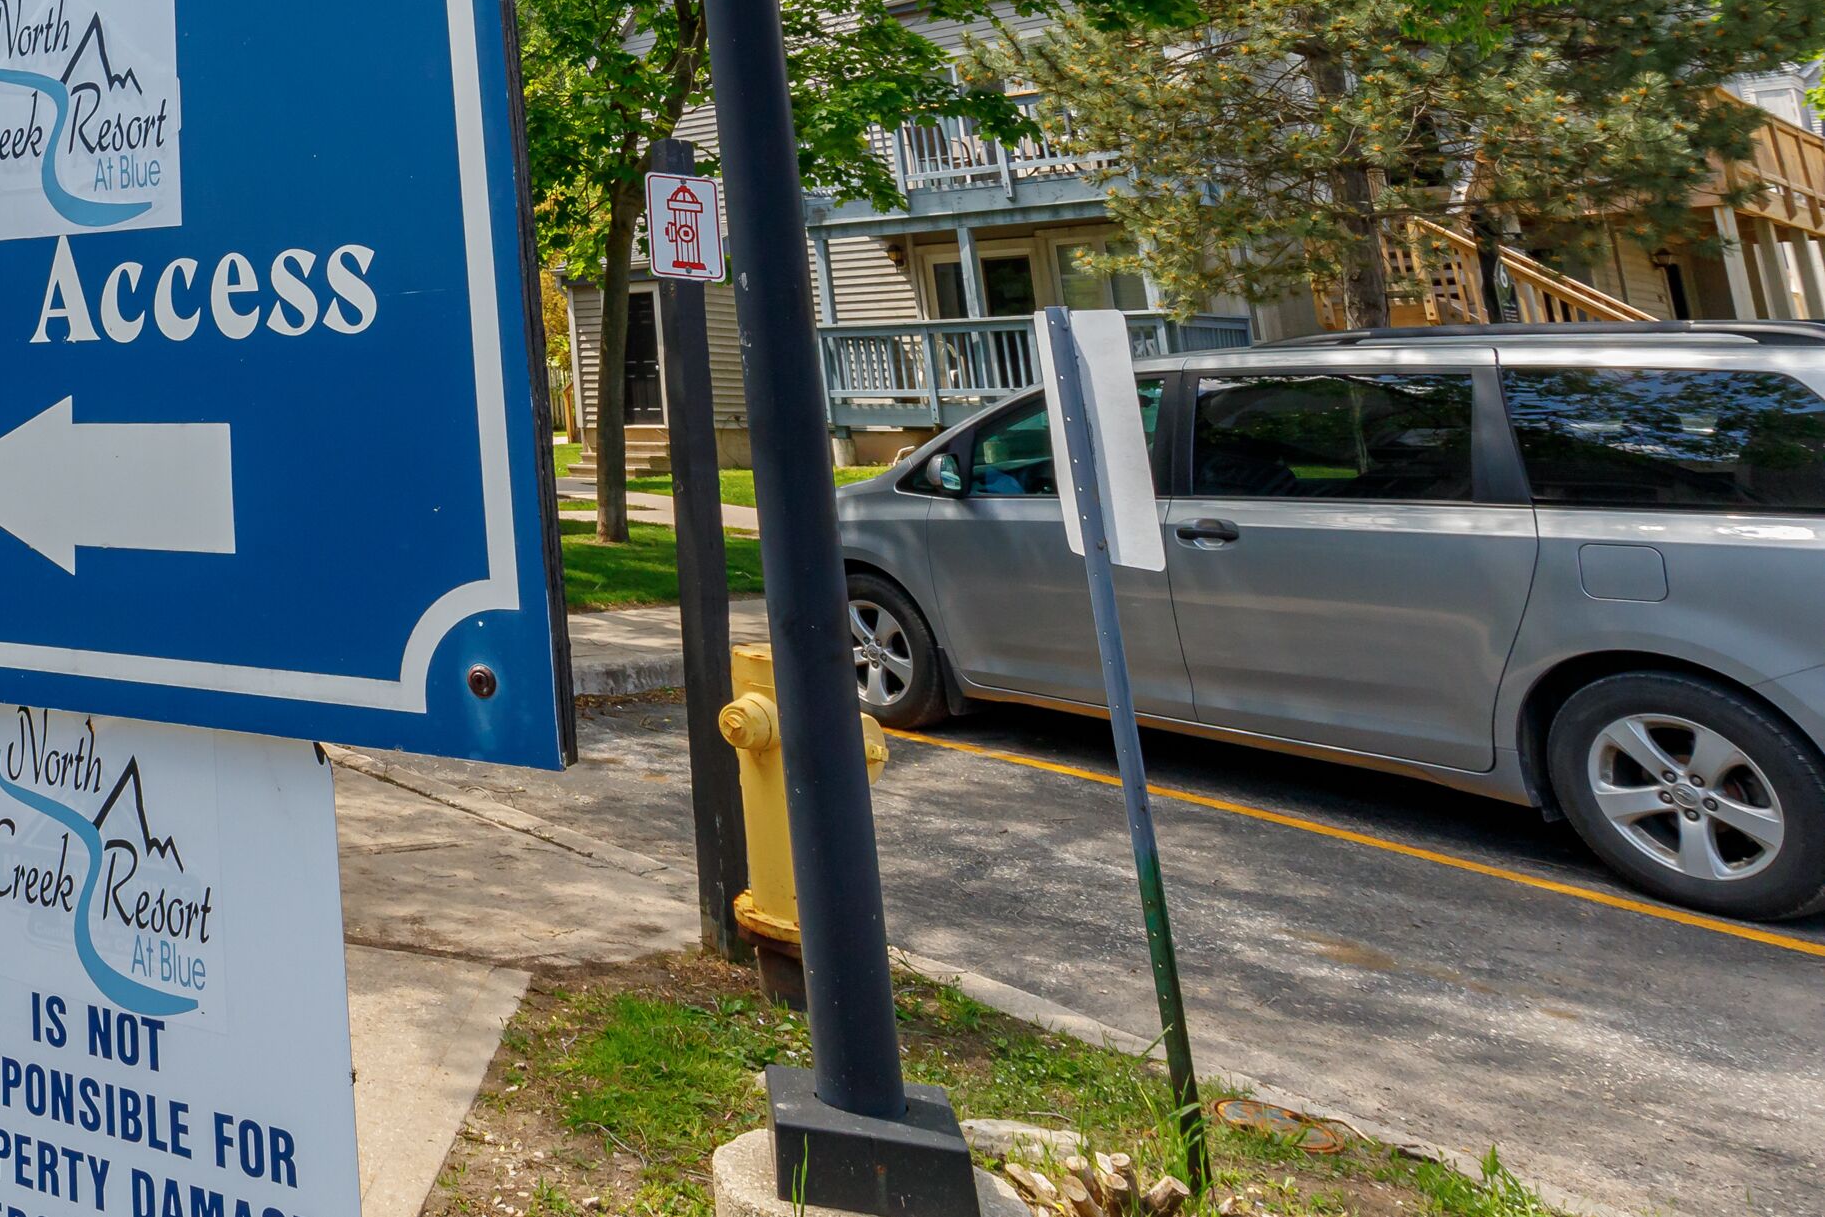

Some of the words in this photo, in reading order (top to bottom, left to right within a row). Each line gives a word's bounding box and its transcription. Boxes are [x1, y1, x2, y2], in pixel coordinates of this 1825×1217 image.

[67, 81, 167, 156] Resort
[93, 157, 115, 193] At
[120, 154, 162, 190] Blue
[29, 235, 379, 343] Access
[6, 705, 103, 793] North
[102, 839, 212, 944] Resort
[130, 934, 154, 978] At
[160, 939, 207, 991] Blue
[31, 991, 67, 1049] IS
[87, 1004, 166, 1072] NOT
[213, 1111, 298, 1189] FOR
